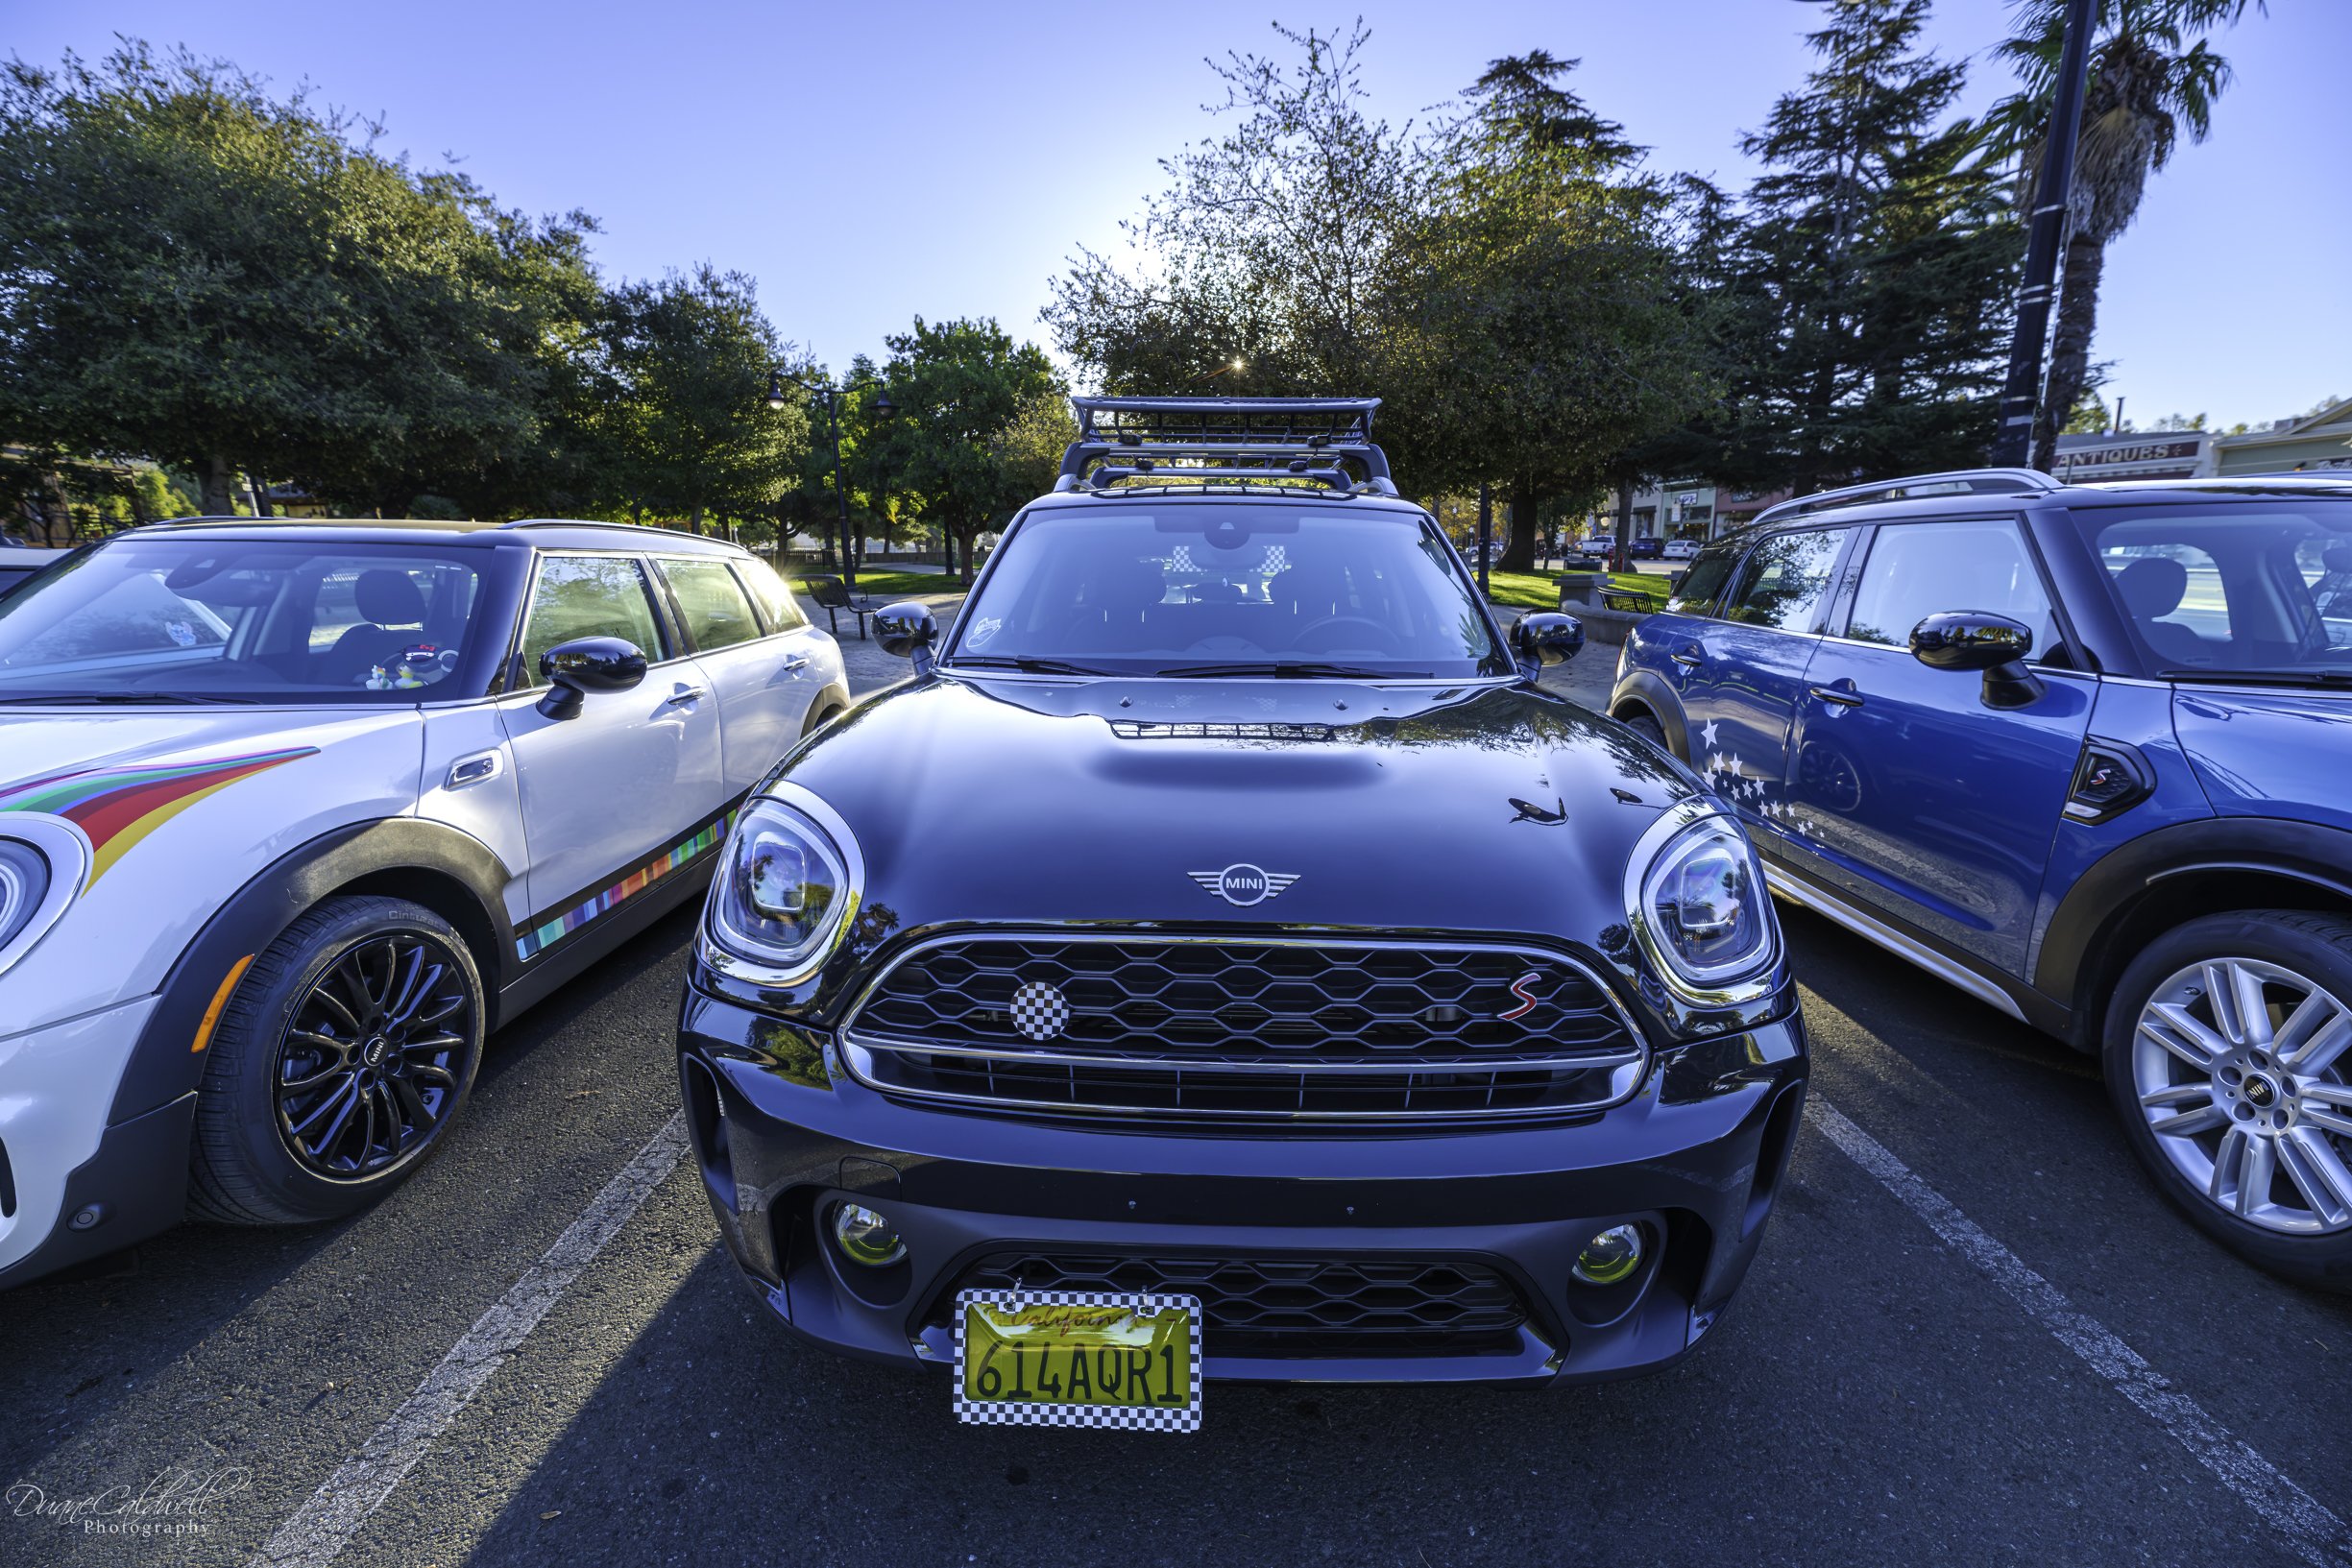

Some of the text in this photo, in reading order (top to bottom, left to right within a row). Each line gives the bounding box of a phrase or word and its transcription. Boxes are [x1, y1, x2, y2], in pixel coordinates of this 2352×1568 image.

[2057, 445, 2170, 467] ANTIQUES
[1225, 878, 1263, 890] MINI
[388, 910, 446, 930] Cinturat
[1496, 972, 1541, 1022] S
[370, 1041, 384, 1063] MINI
[2246, 1081, 2269, 1100] MINI
[976, 1339, 1183, 1403] 614AQR1
